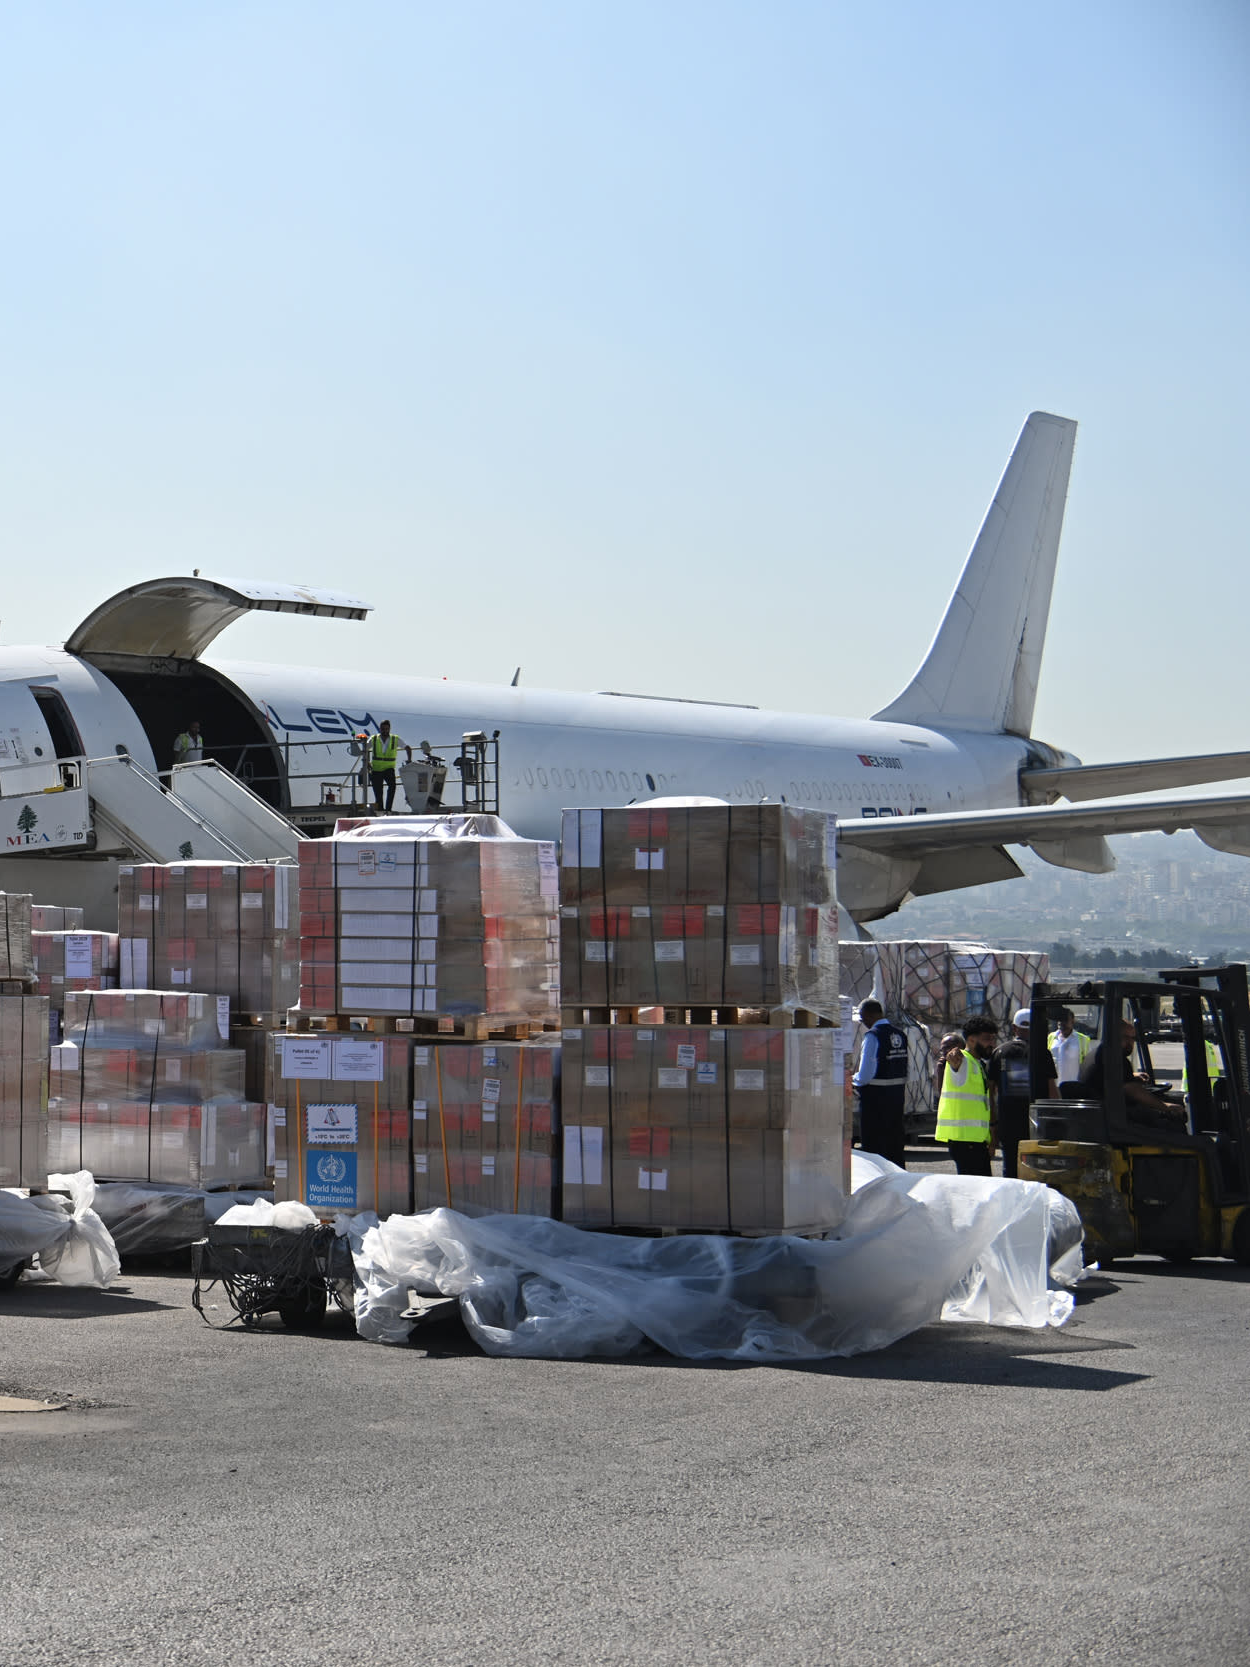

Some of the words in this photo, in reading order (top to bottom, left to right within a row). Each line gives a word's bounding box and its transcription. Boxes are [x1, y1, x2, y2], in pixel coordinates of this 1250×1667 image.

[6, 833, 50, 847] MEA
[309, 1184, 330, 1193] World
[332, 1186, 354, 1195] Health
[309, 1194, 354, 1204] Organization
